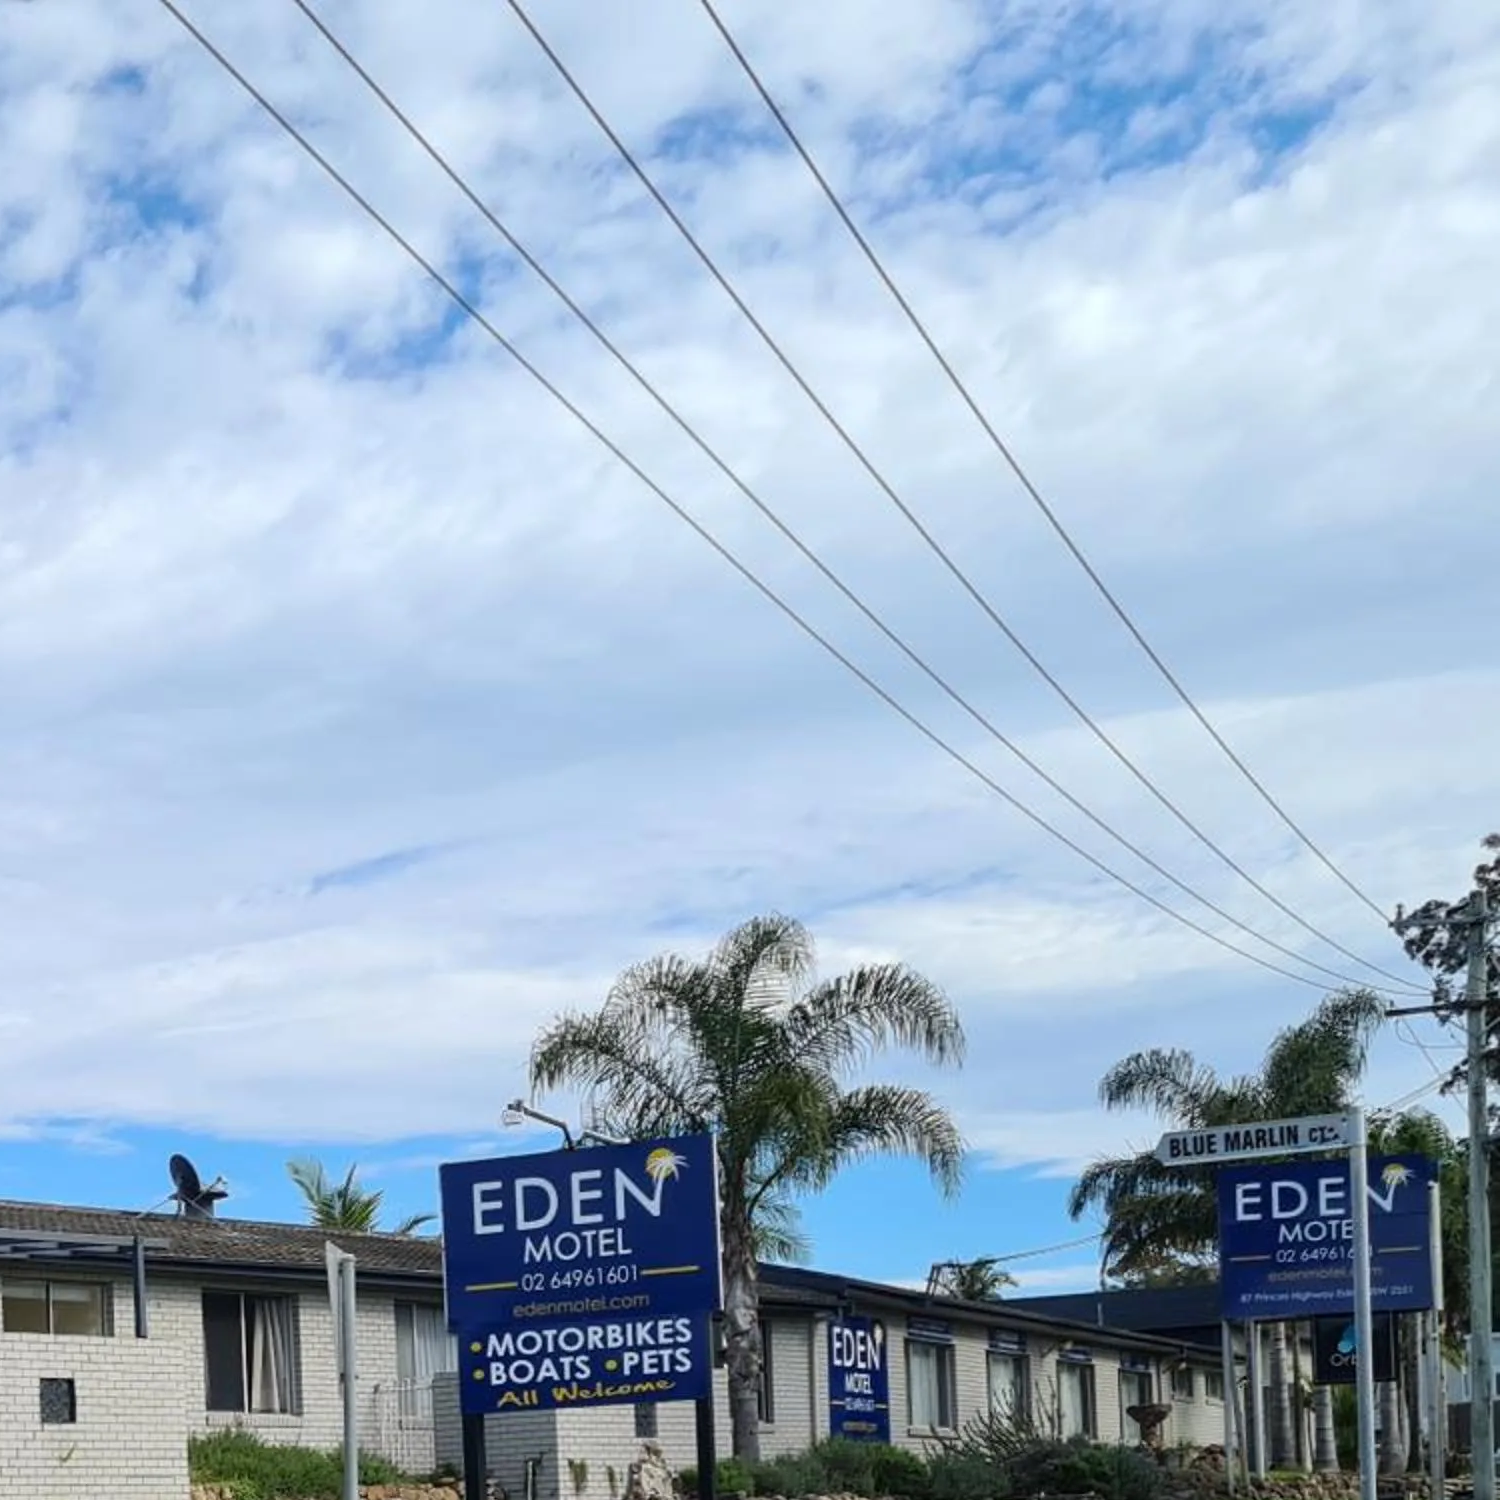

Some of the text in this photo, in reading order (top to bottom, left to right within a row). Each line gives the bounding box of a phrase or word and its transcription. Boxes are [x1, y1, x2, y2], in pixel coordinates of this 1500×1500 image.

[1169, 1135, 1218, 1158] BLUE
[1224, 1124, 1299, 1152] MARLIN
[472, 1167, 665, 1235] EDEN
[523, 1227, 633, 1264] MOTEL
[1278, 1219, 1355, 1244] MOTE
[1276, 1245, 1373, 1263] 02 6496161
[521, 1265, 639, 1292] 02 64961601
[512, 1293, 650, 1318] edenmotel.com
[486, 1317, 693, 1358] MOTORBIKES
[832, 1325, 880, 1371] EDEN
[490, 1347, 692, 1386] BOATS PETS
[496, 1378, 676, 1407] All Welcome
